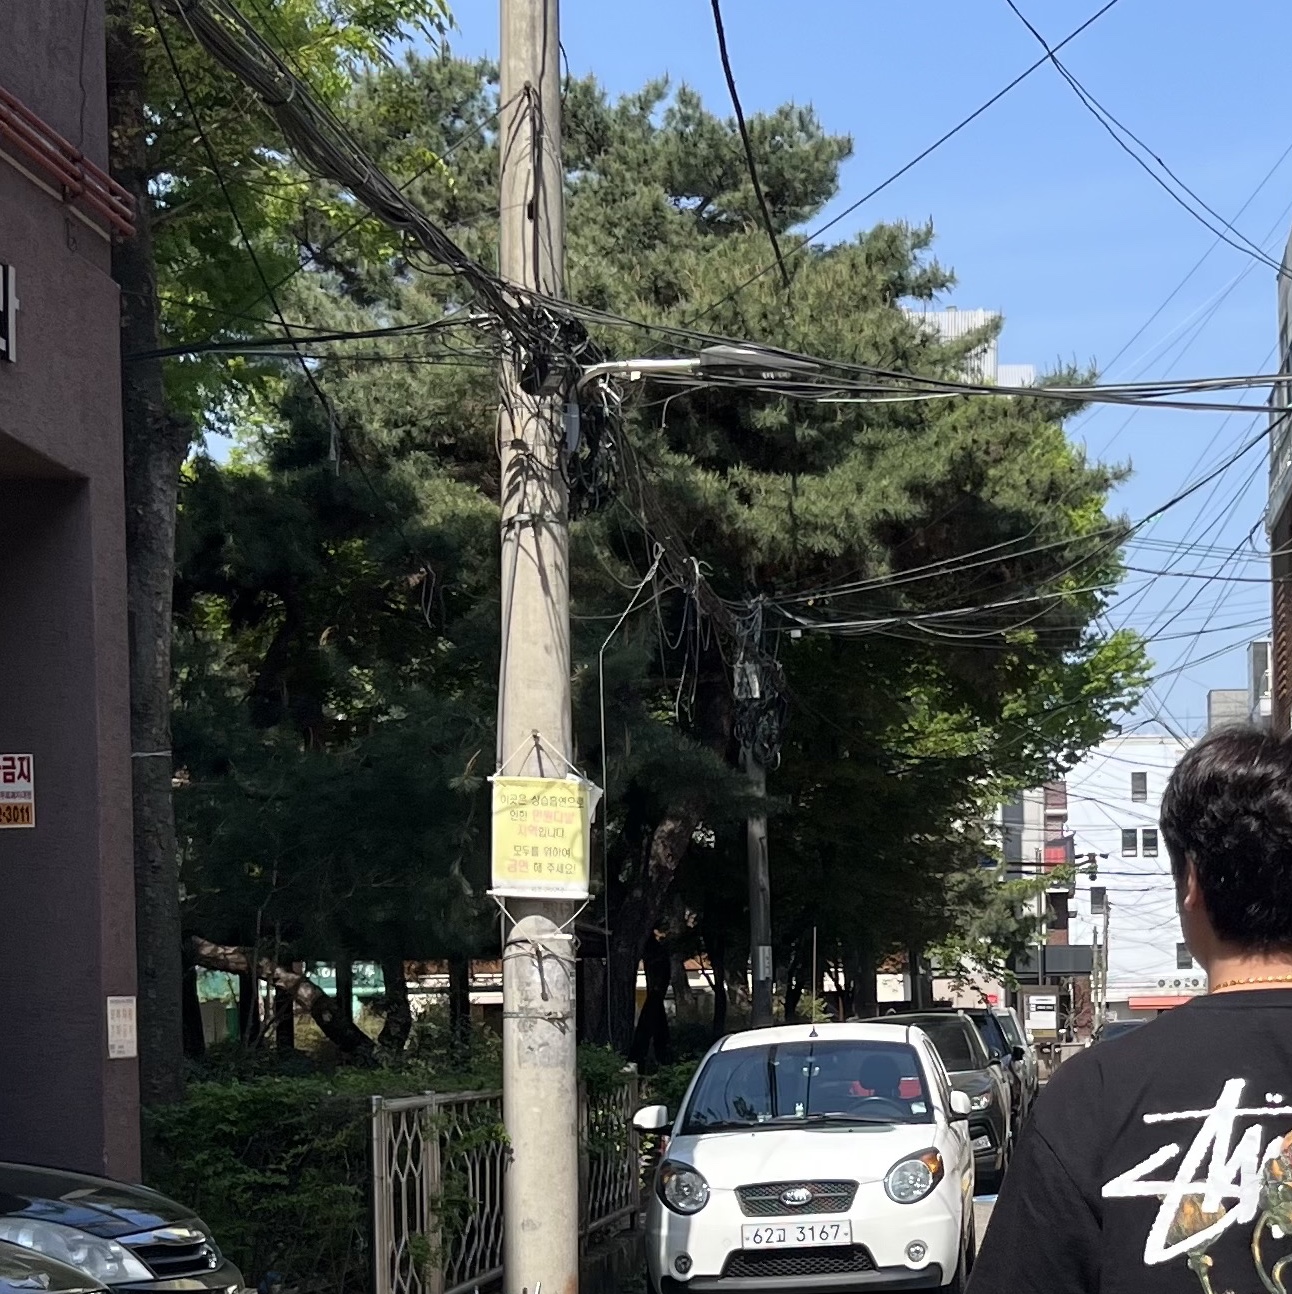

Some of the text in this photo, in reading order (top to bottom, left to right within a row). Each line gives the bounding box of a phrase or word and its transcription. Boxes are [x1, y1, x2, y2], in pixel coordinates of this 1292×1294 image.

[0, 756, 31, 783] 금지
[501, 794, 527, 806] 이곳은
[0, 805, 30, 823] -3011
[510, 810, 527, 822] 인한
[513, 845, 539, 857] 모두를
[752, 1224, 840, 1244] 62고 3167
